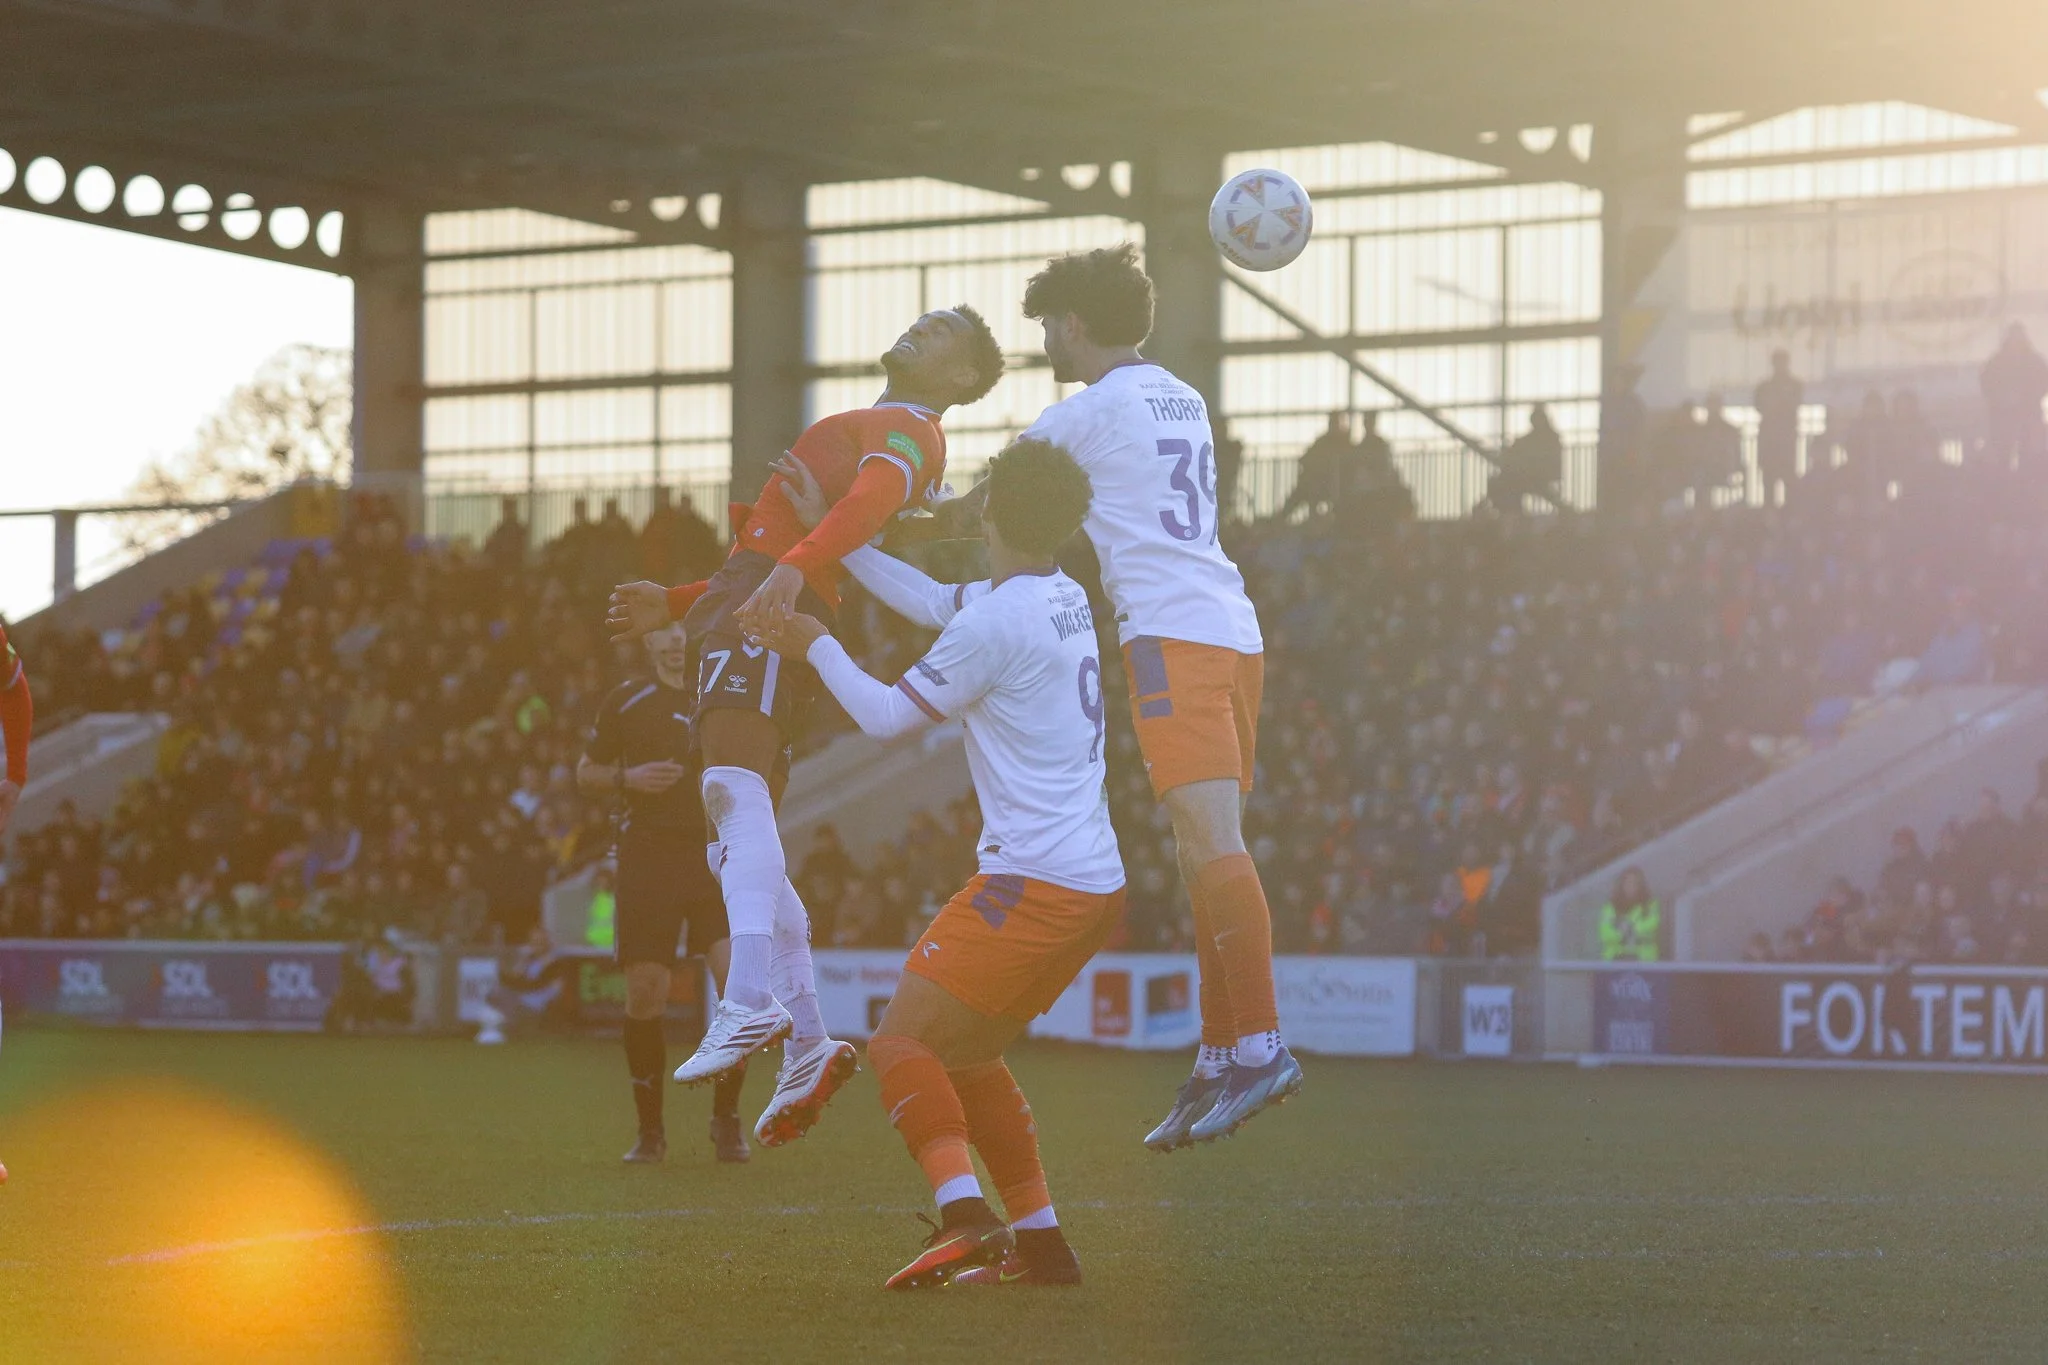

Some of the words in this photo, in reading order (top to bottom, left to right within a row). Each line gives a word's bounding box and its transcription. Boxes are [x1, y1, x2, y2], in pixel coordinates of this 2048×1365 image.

[1156, 438, 1219, 546] 39
[1078, 656, 1104, 763] 9
[58, 959, 110, 996] SDL
[161, 960, 214, 997] SDL
[267, 961, 321, 999] SDL
